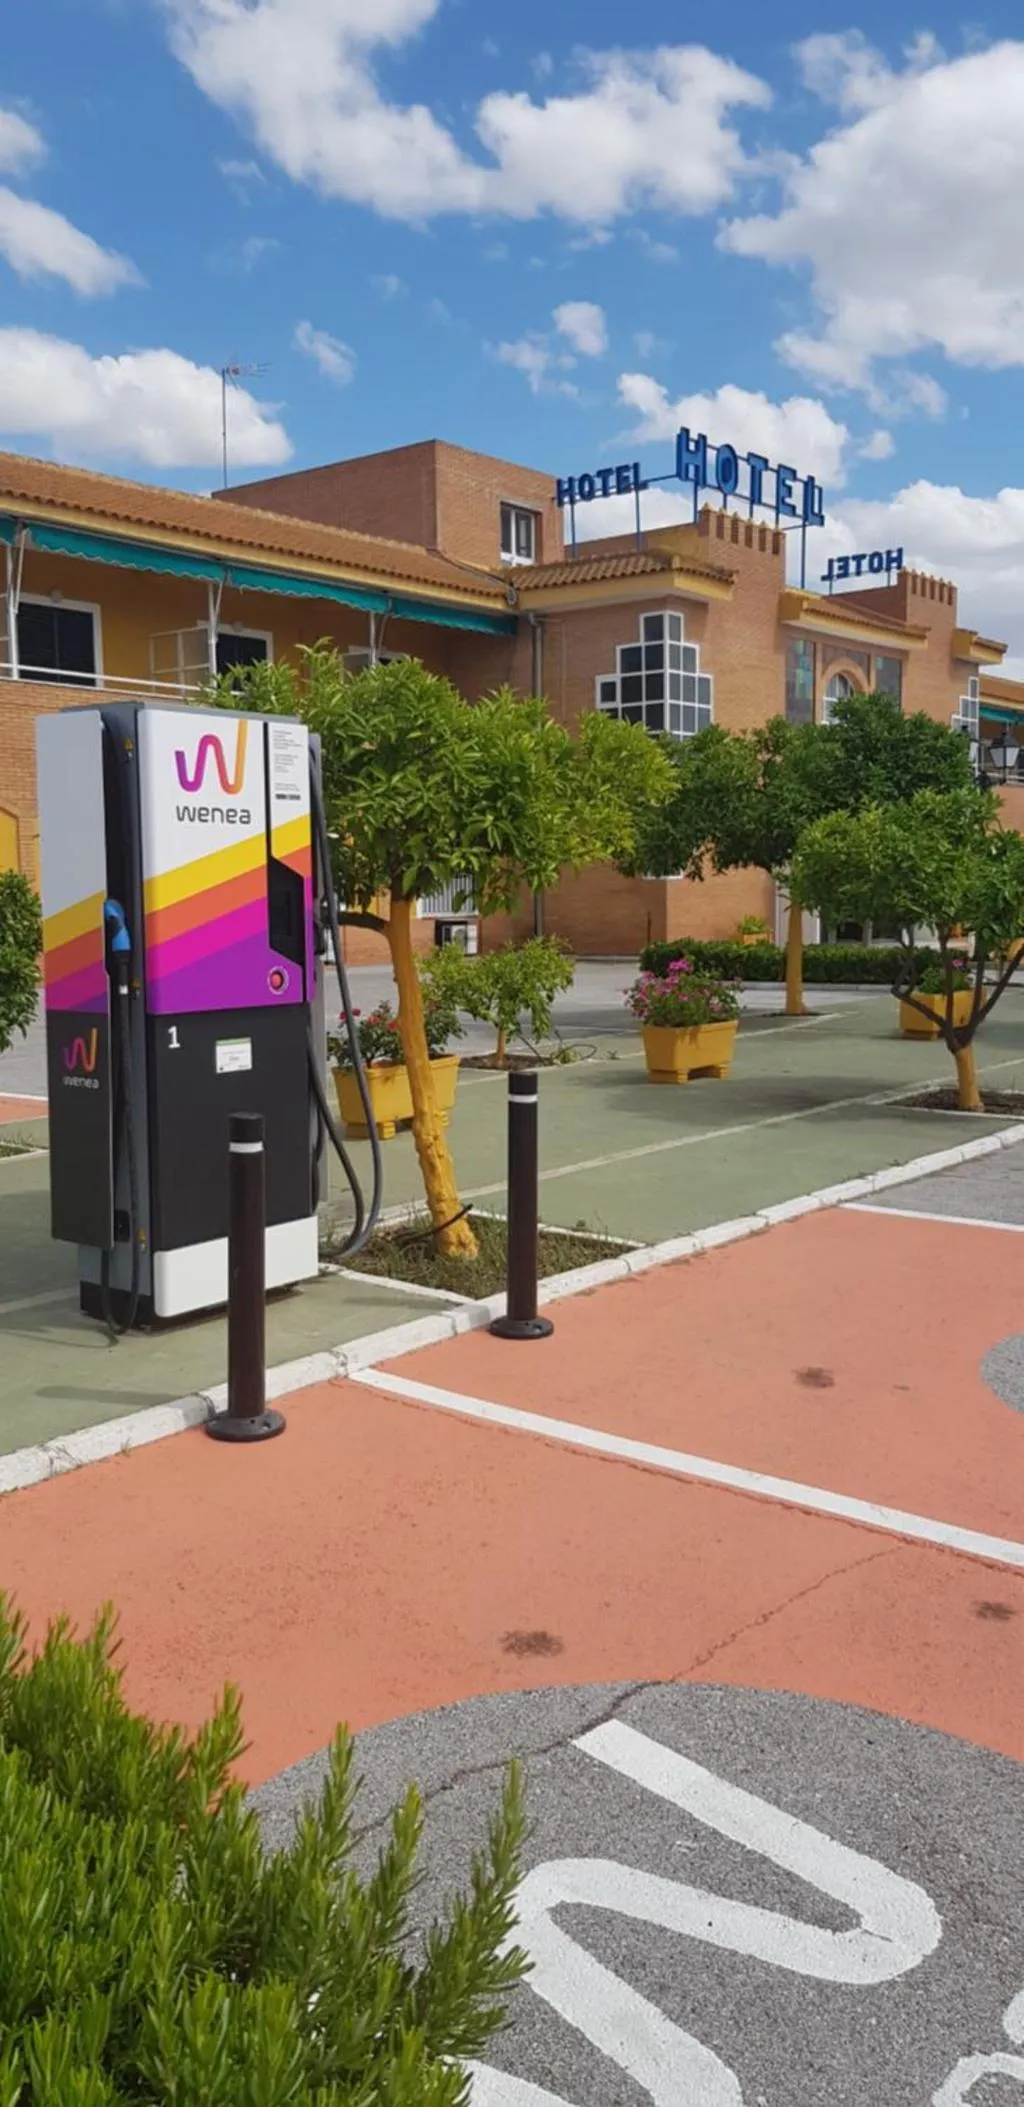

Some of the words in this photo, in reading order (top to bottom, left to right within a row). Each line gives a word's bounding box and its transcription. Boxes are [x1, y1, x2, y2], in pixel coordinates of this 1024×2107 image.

[556, 462, 649, 508] HOTEL
[676, 426, 825, 527] HOTEL
[176, 805, 251, 825] wenea
[167, 1025, 181, 1049] 1
